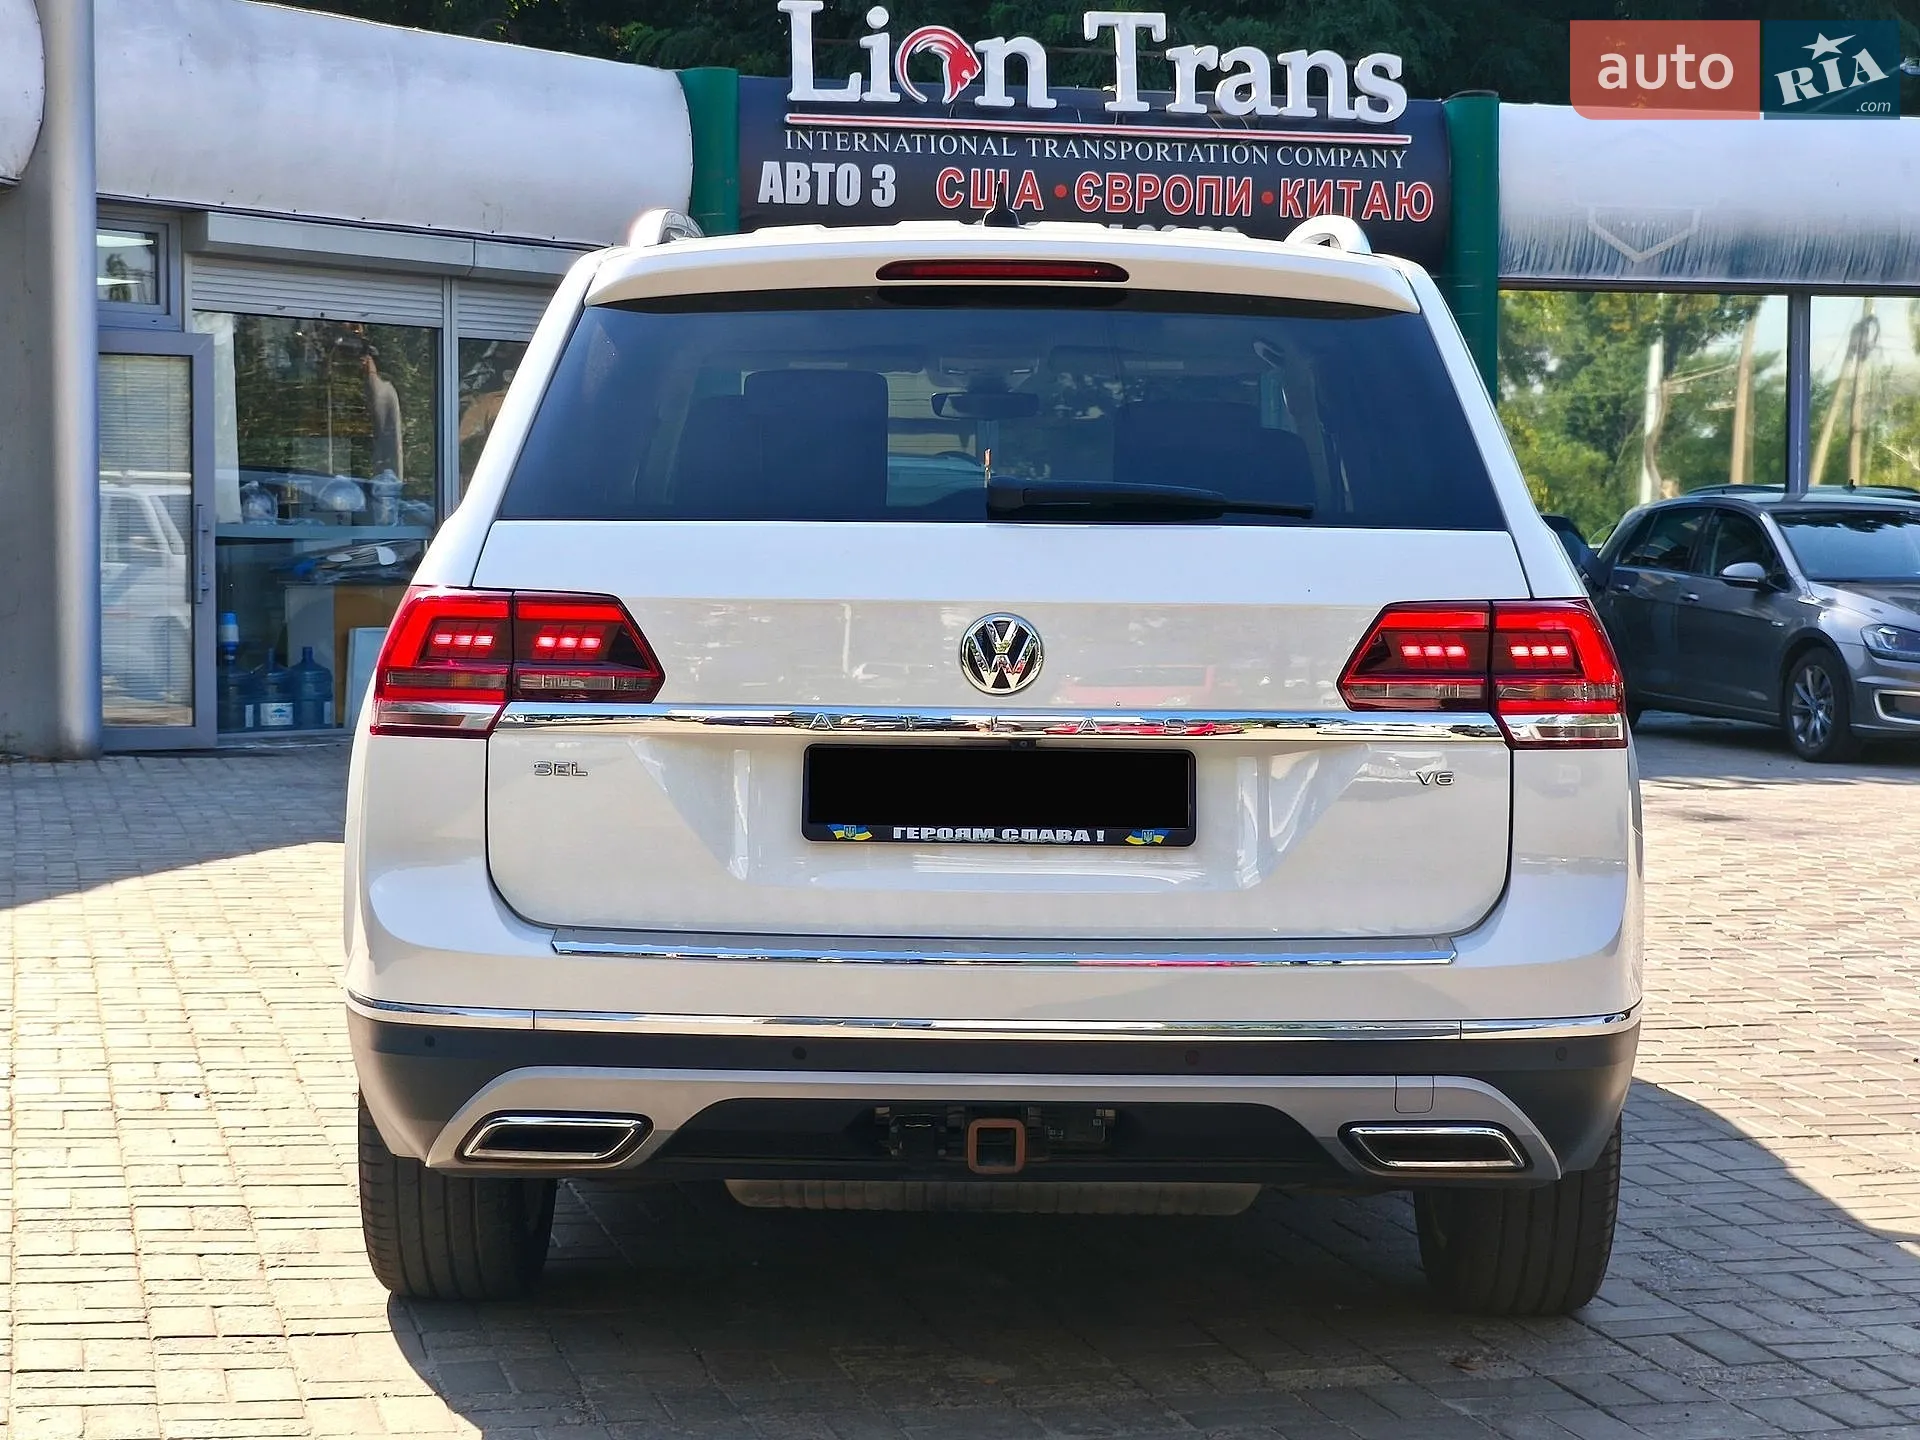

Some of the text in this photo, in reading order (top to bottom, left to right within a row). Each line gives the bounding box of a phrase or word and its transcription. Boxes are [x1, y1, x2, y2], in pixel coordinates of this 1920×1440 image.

[1083, 10, 1408, 124] Trans
[784, 129, 1407, 169] INTERNATIONAL TRANSPORTATION COMPANY
[758, 161, 862, 206] АВТО
[936, 167, 1045, 212] США
[1074, 171, 1253, 218] ЄВРОПИ
[1279, 177, 1434, 222] КИТАЮ
[808, 712, 1187, 736] ATLAS
[534, 760, 588, 776] SEL
[1416, 771, 1455, 785] V6
[893, 826, 995, 842] ГЕРОЯМ
[1002, 828, 1091, 843] СЛАВА
